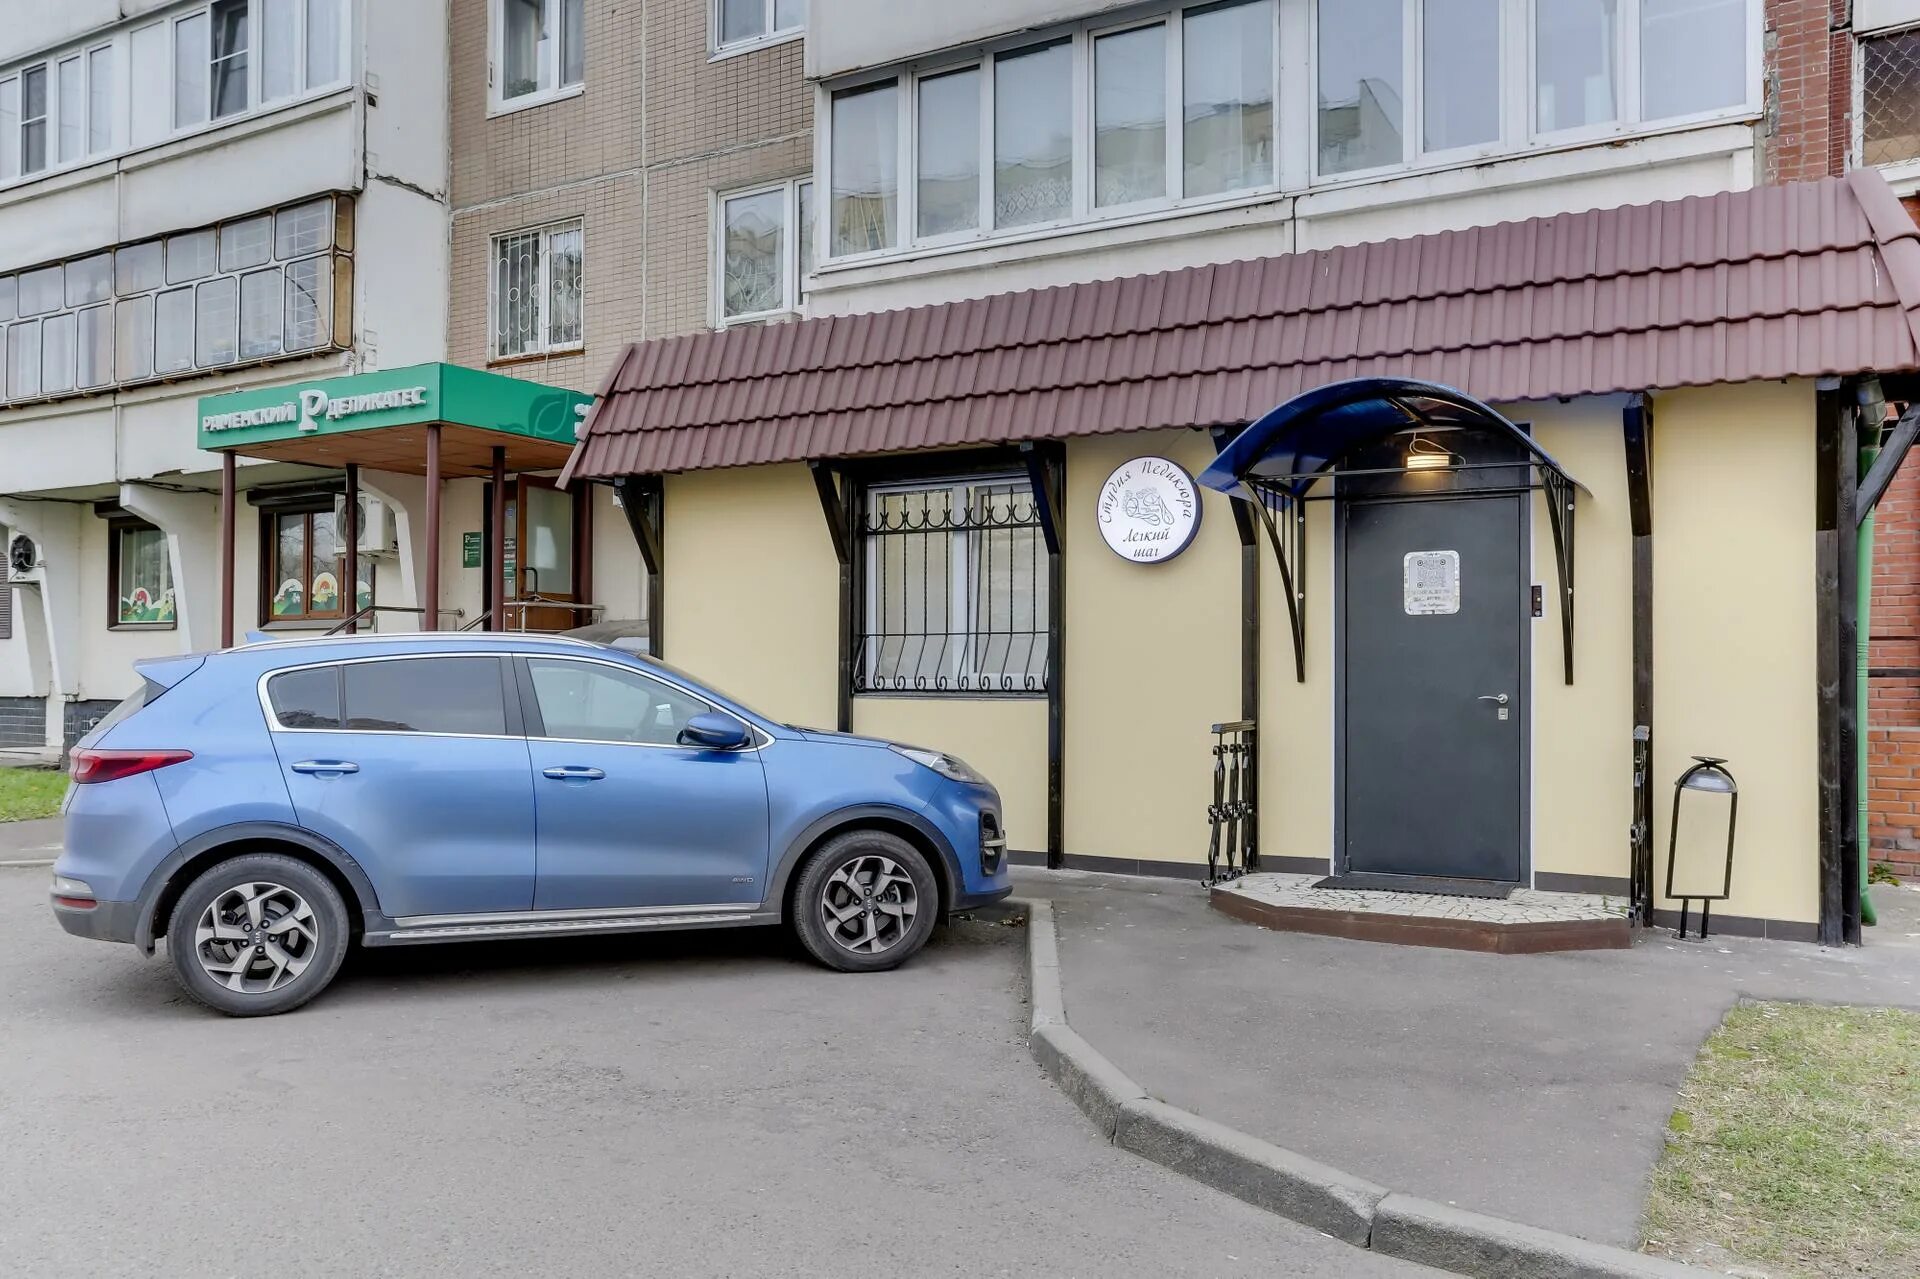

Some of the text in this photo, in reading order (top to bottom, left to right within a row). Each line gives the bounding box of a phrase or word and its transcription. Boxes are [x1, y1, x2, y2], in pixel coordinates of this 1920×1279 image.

[203, 402, 297, 432] РАМЕНСКИЙ
[325, 386, 427, 421] ДЕЛИКАТЕС
[1099, 460, 1192, 524] Студия Педикюра
[1122, 527, 1170, 543] Легкий
[1133, 547, 1160, 558] шаг
